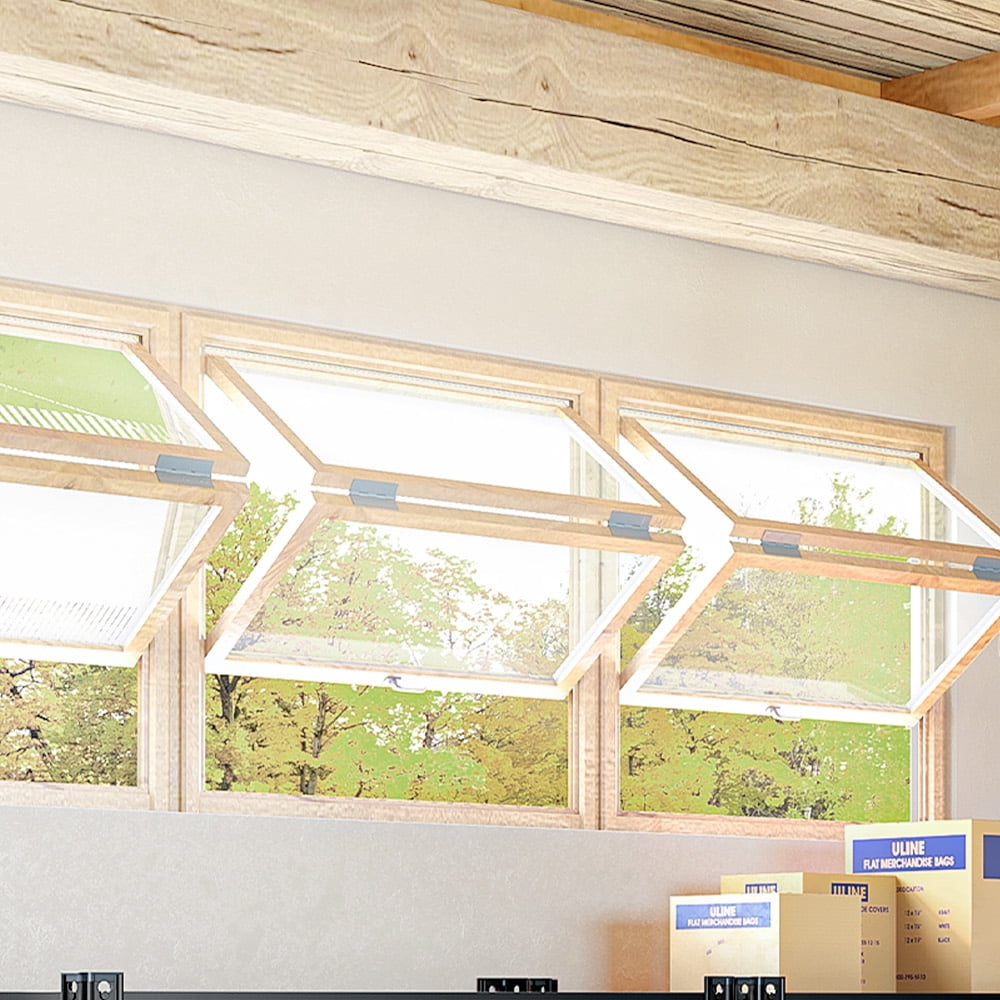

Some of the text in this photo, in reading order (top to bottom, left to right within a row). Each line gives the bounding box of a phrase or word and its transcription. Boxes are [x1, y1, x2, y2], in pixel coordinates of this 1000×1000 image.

[891, 840, 925, 856] ULINE
[863, 856, 954, 870] FLAT MERCHANDISE BAGS
[709, 906, 737, 917] ULINE
